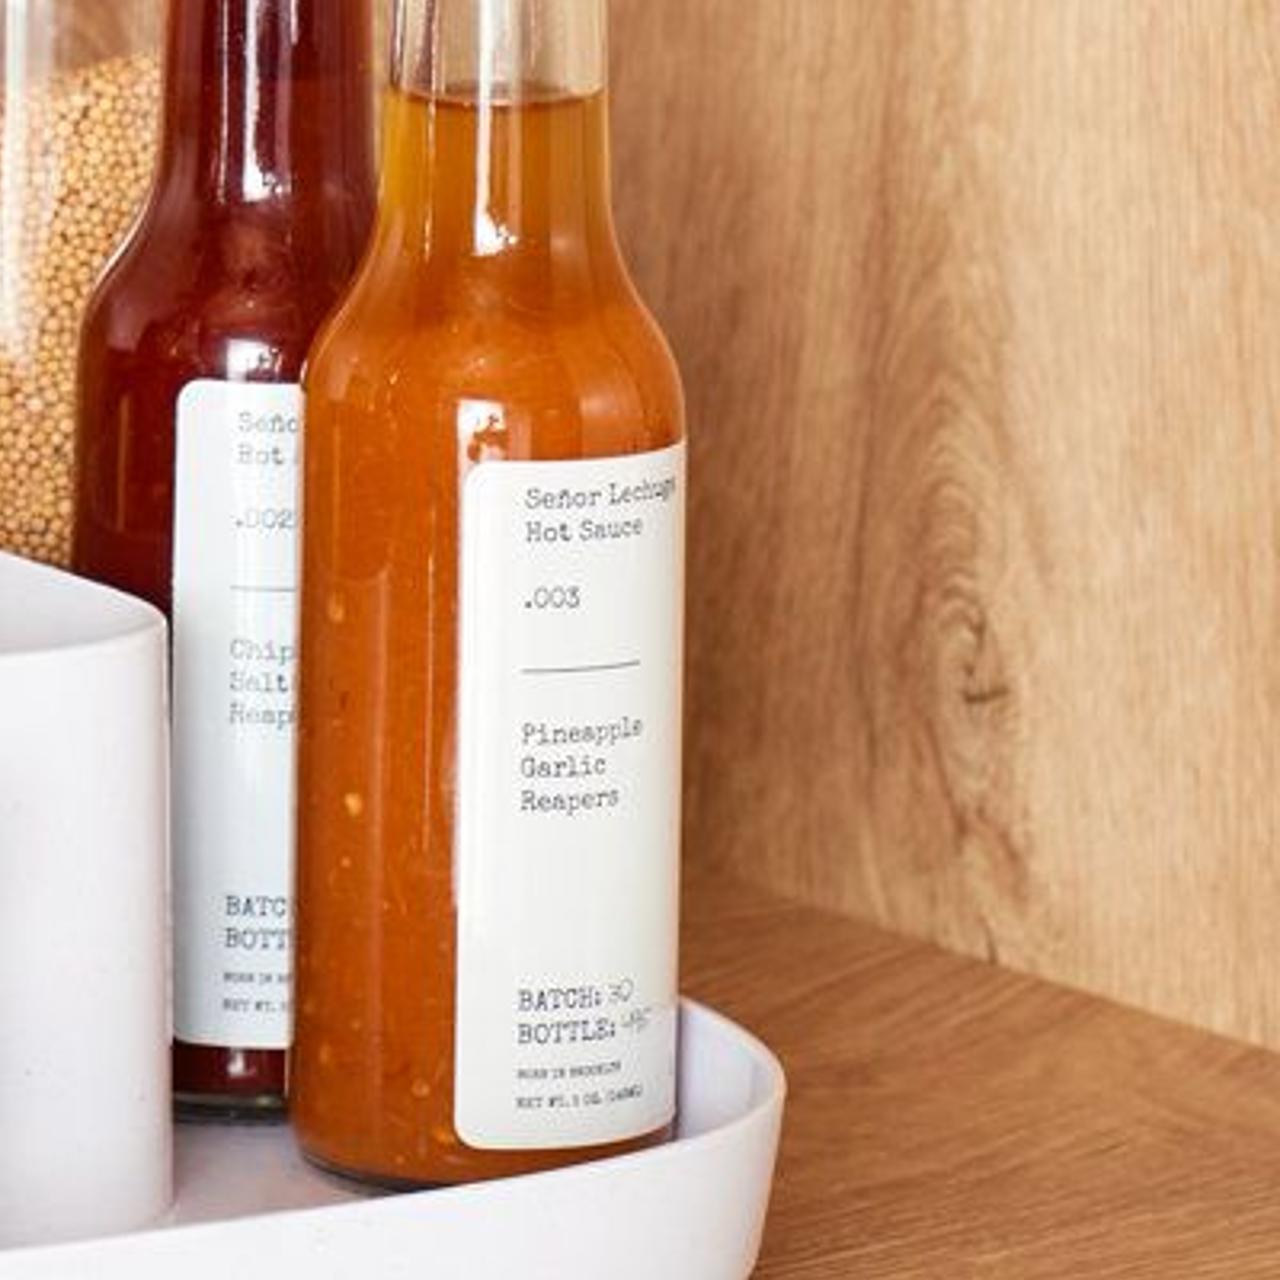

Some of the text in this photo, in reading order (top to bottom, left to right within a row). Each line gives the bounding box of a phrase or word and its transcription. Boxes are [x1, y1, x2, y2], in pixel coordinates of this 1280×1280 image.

[526, 518, 642, 542] Hot Sauce
[525, 586, 580, 609] .003
[521, 716, 643, 746] Pineapple
[521, 754, 606, 778] Garlic
[521, 789, 619, 817] Reapers
[517, 986, 601, 1012] BATCH:
[517, 1018, 616, 1045] BOTTLE:
